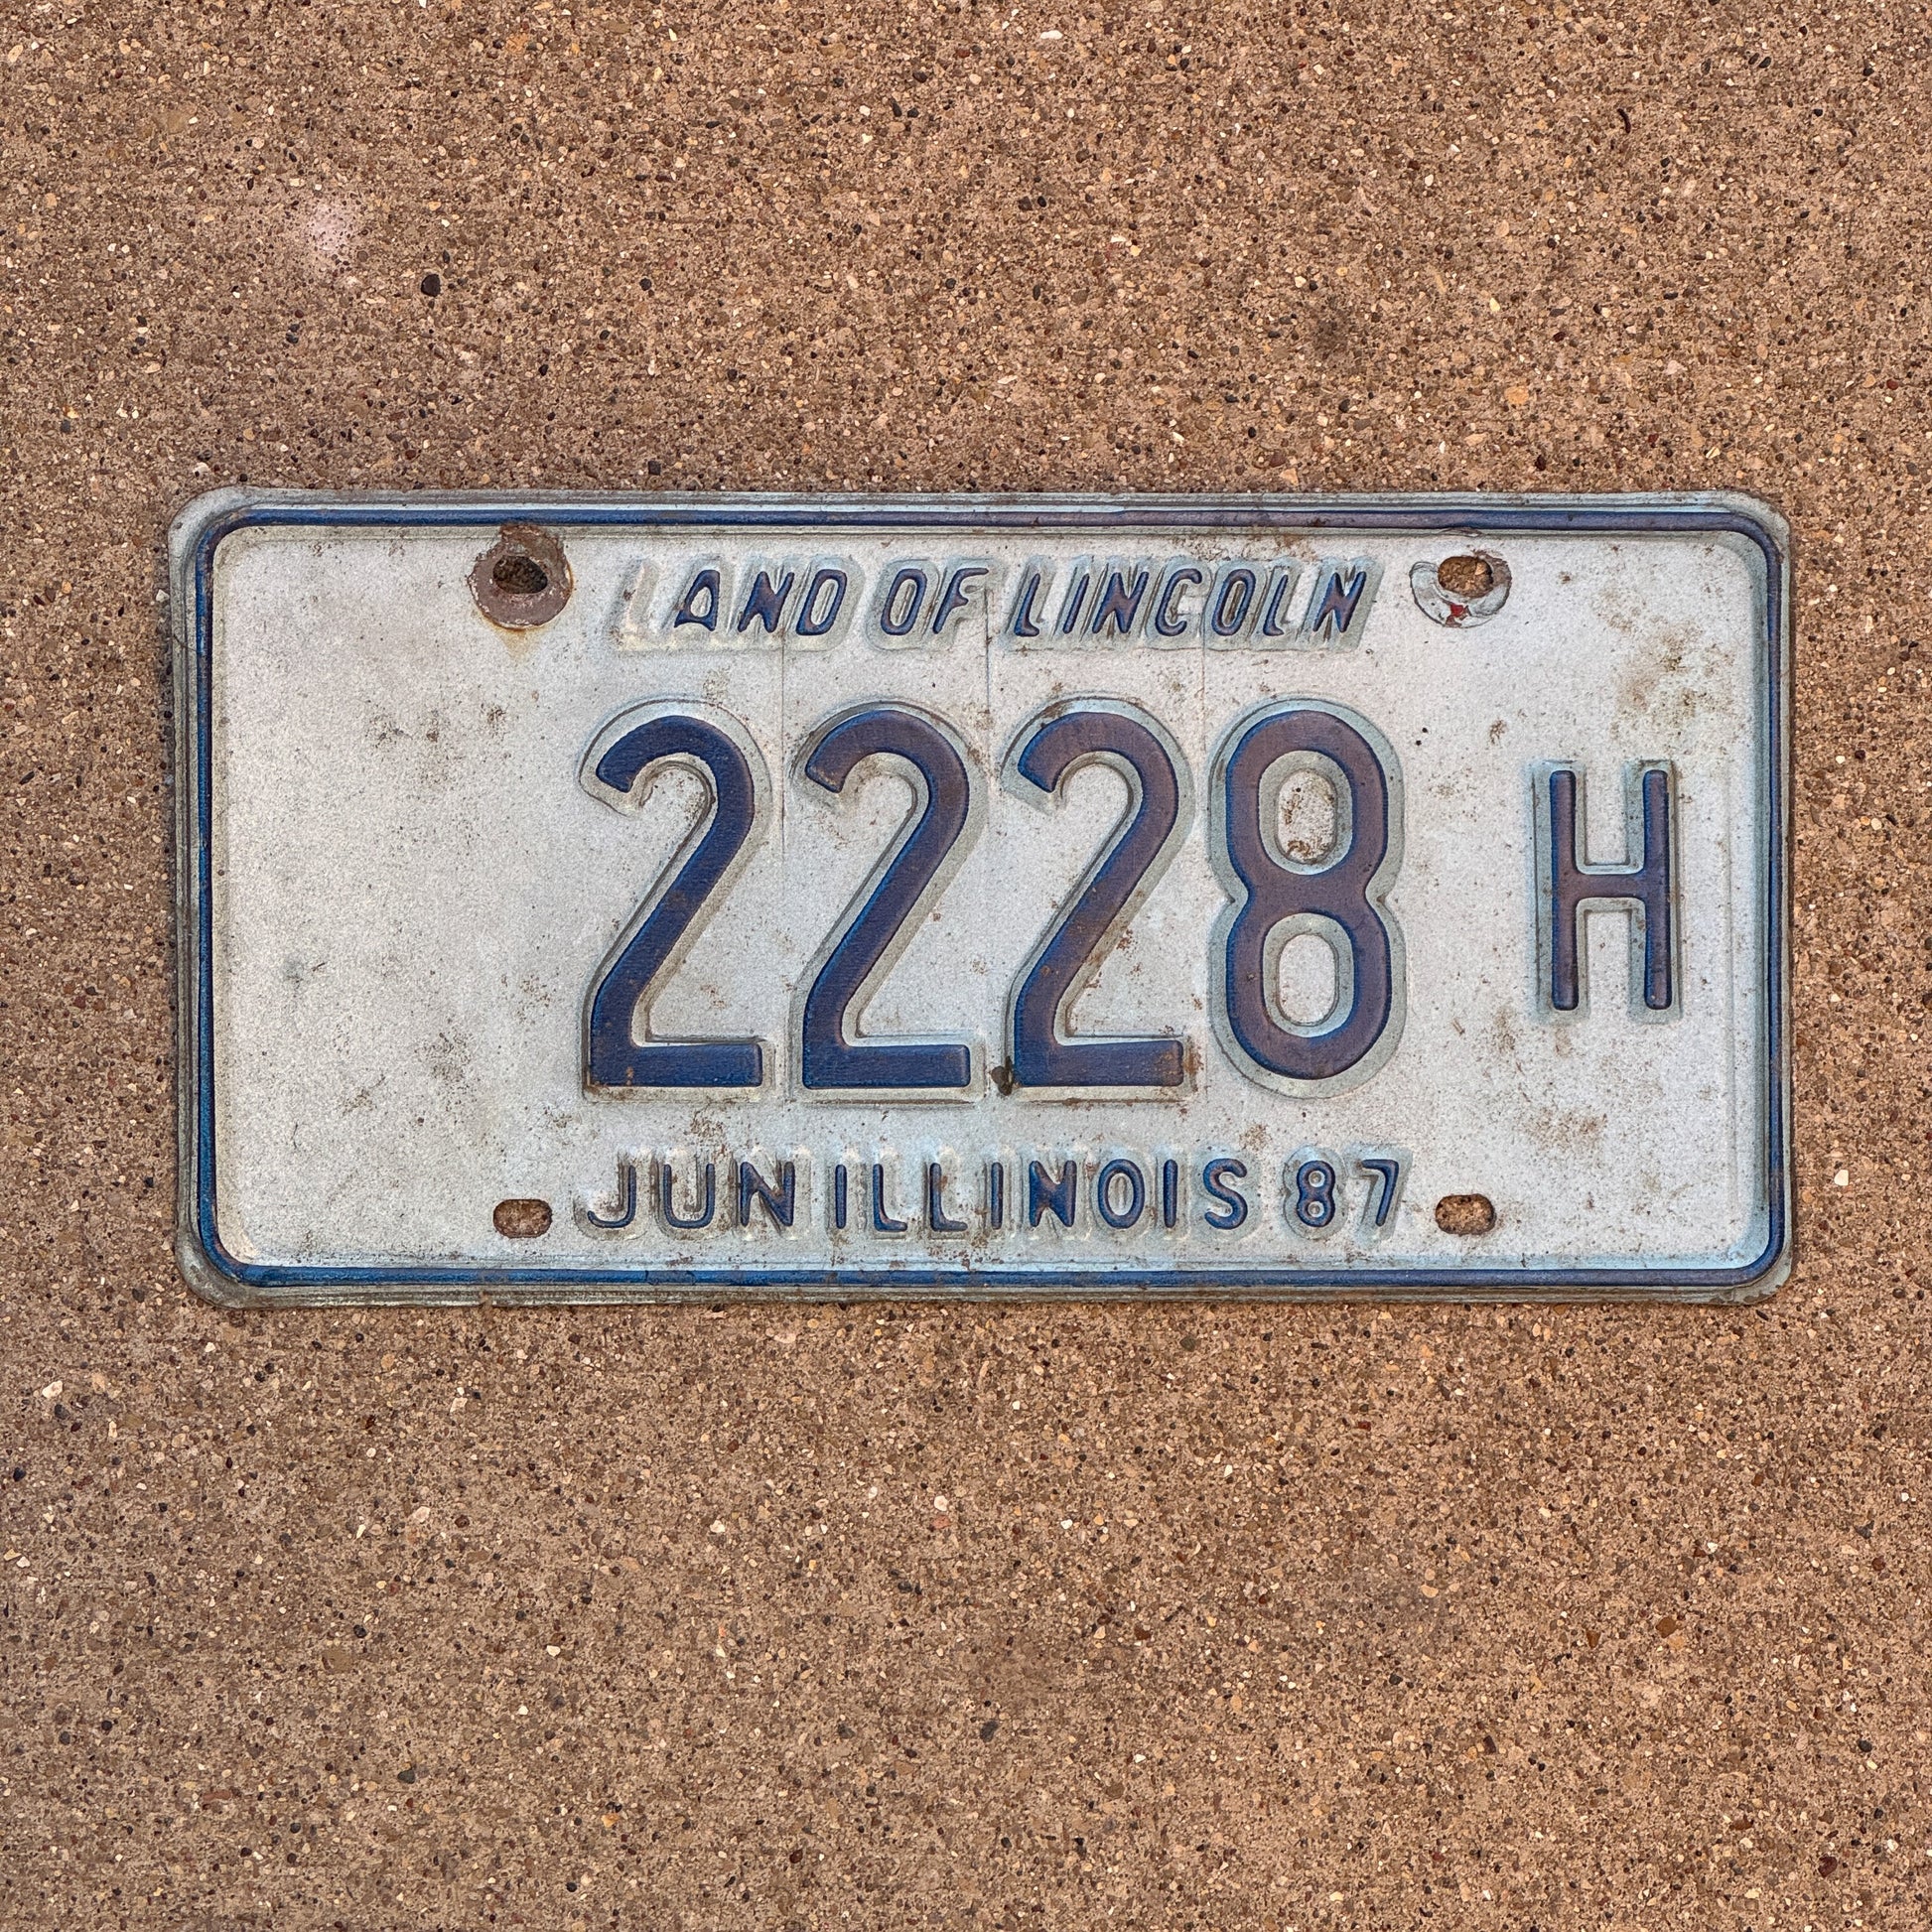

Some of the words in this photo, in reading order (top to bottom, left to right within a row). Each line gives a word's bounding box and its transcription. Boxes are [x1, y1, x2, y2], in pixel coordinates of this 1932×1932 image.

[616, 561, 848, 639] LAND
[879, 567, 990, 636] OF
[1012, 567, 1367, 637] LINCOLN
[593, 708, 1392, 1090] 2228
[1548, 768, 1673, 1012] H
[586, 1160, 795, 1230] JUN
[834, 1158, 1249, 1232] ILLINOIS
[1295, 1158, 1400, 1229] 87
